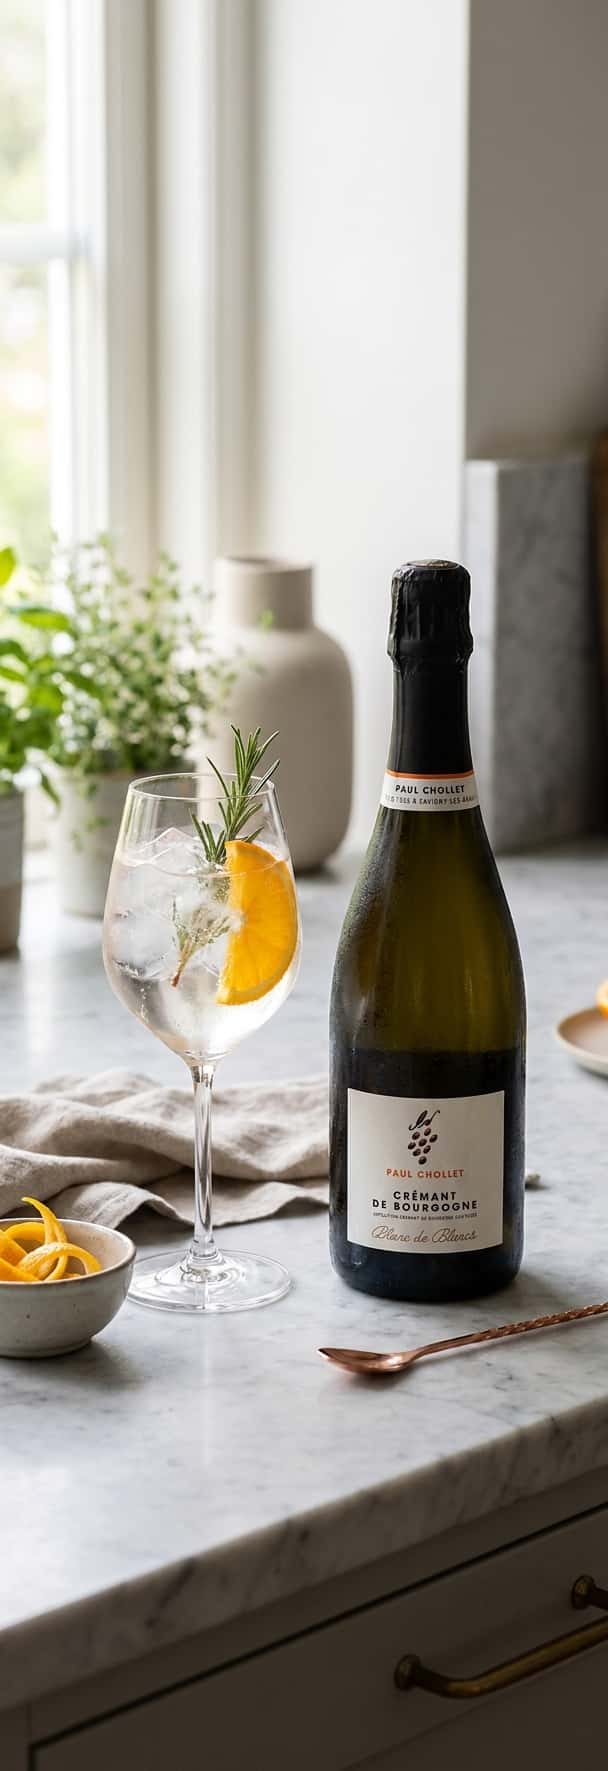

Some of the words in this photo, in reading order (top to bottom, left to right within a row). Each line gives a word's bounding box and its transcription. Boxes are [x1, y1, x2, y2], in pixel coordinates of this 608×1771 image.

[396, 785, 419, 794] PAUL
[423, 785, 465, 794] CHOLLET
[386, 1169, 413, 1178] PAUL
[417, 1169, 464, 1179] CHOLLET
[393, 1190, 456, 1200] CRÉMANT
[372, 1199, 387, 1208] DE
[394, 1200, 478, 1212] BOURGOGNE
[372, 1226, 410, 1242] Blanc
[413, 1230, 429, 1243] de
